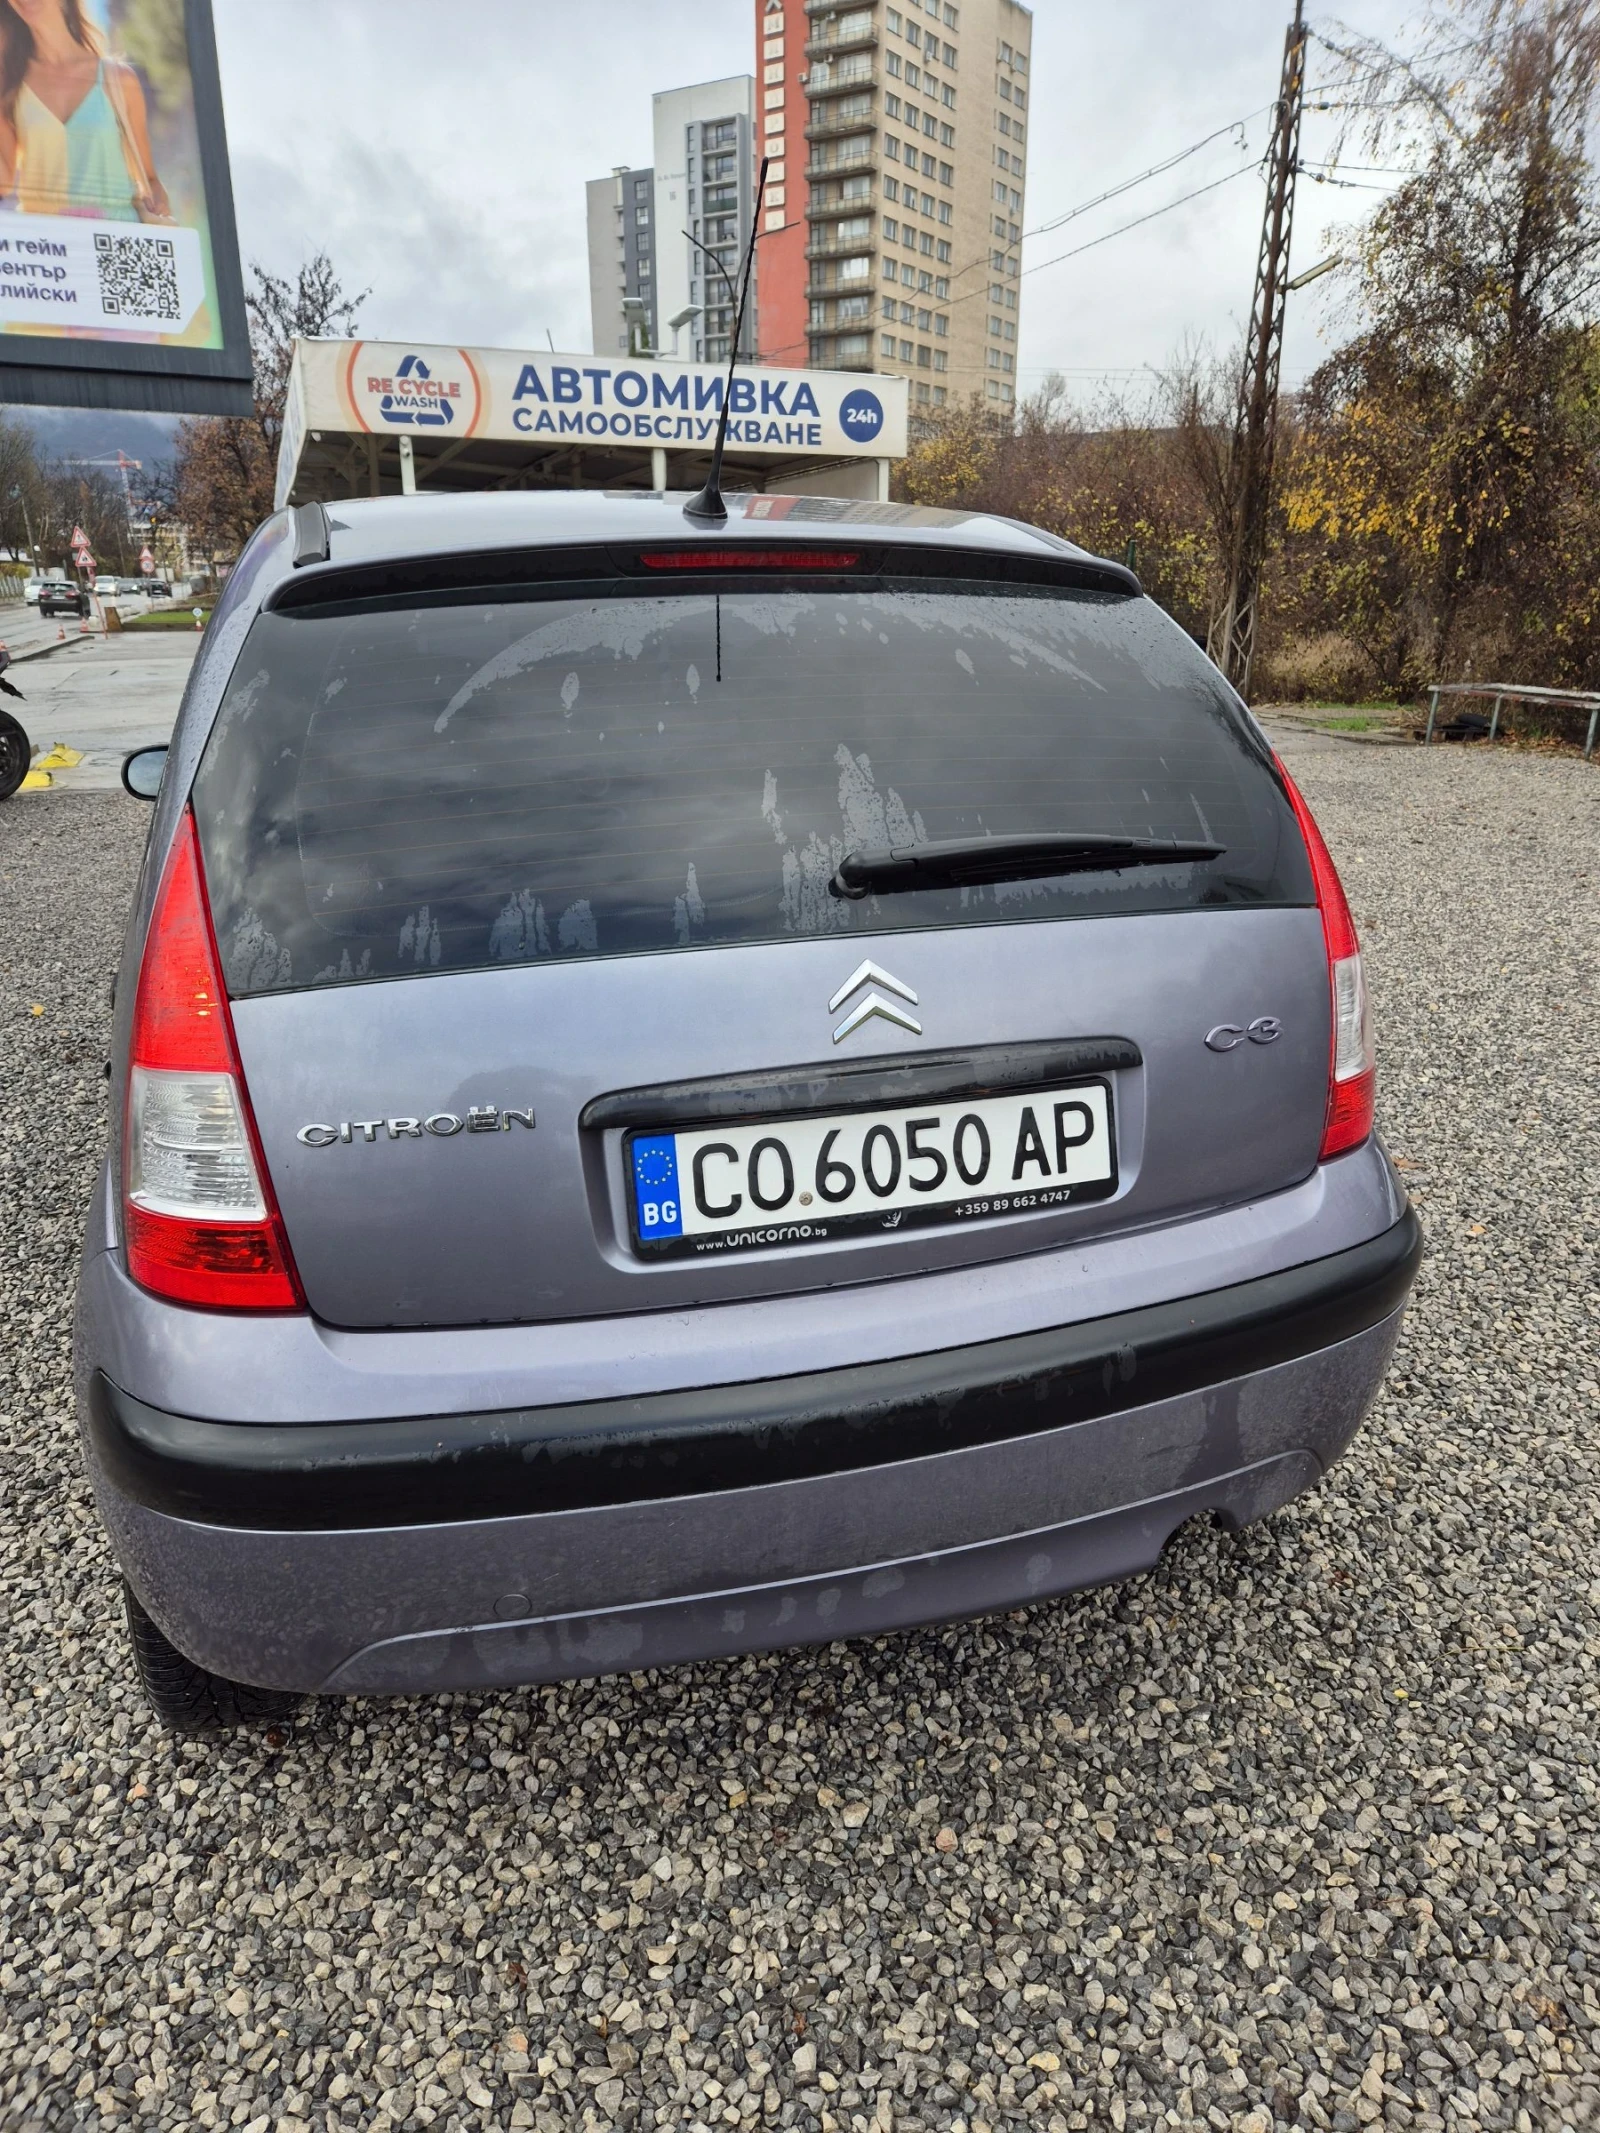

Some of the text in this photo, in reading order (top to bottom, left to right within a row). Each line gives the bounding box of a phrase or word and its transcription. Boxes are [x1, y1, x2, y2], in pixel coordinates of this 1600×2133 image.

[15, 238, 67, 257] гейм
[0, 261, 67, 283] ентър
[367, 376, 461, 398] RE CYCLE
[512, 364, 821, 418] АВТОМИВКА
[394, 395, 438, 408] WASH
[846, 408, 878, 424] 24h
[1203, 1016, 1284, 1053] C3
[296, 1105, 537, 1147] CITROËN
[692, 1100, 1095, 1219] CO 6050 AP
[643, 1200, 677, 1226] BG
[955, 1189, 1071, 1216] +359 89 662 4747
